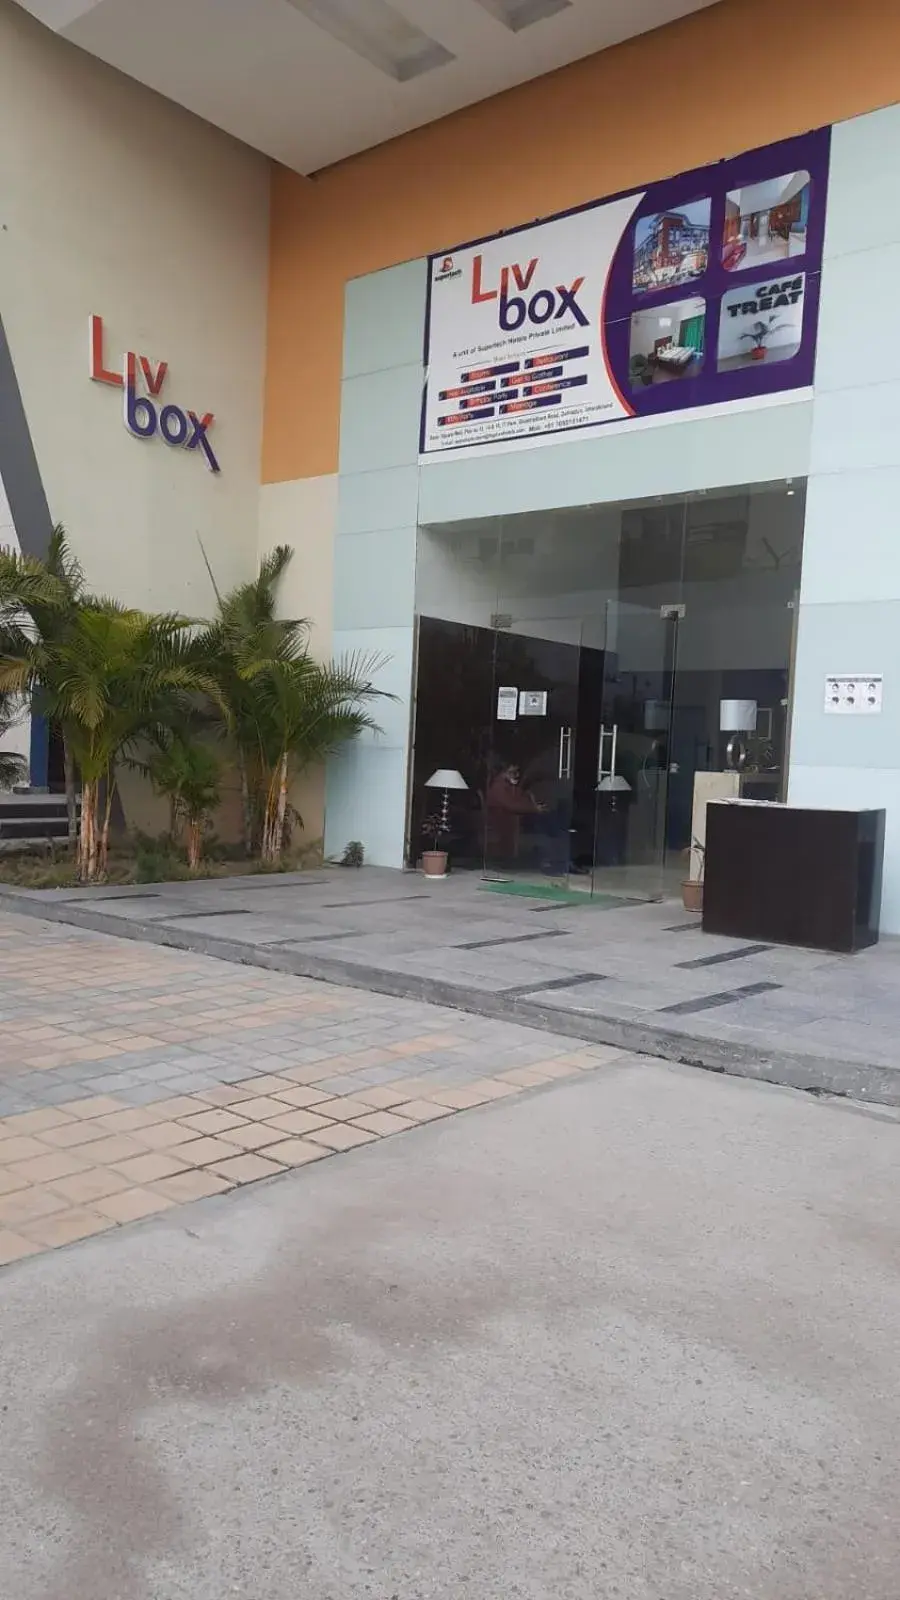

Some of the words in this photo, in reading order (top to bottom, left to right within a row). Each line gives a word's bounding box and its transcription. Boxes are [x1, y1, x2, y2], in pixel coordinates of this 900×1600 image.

[727, 290, 803, 317] TREAT
[477, 339, 507, 353] Supertech
[528, 329, 550, 340] Private
[551, 323, 575, 335] Limited
